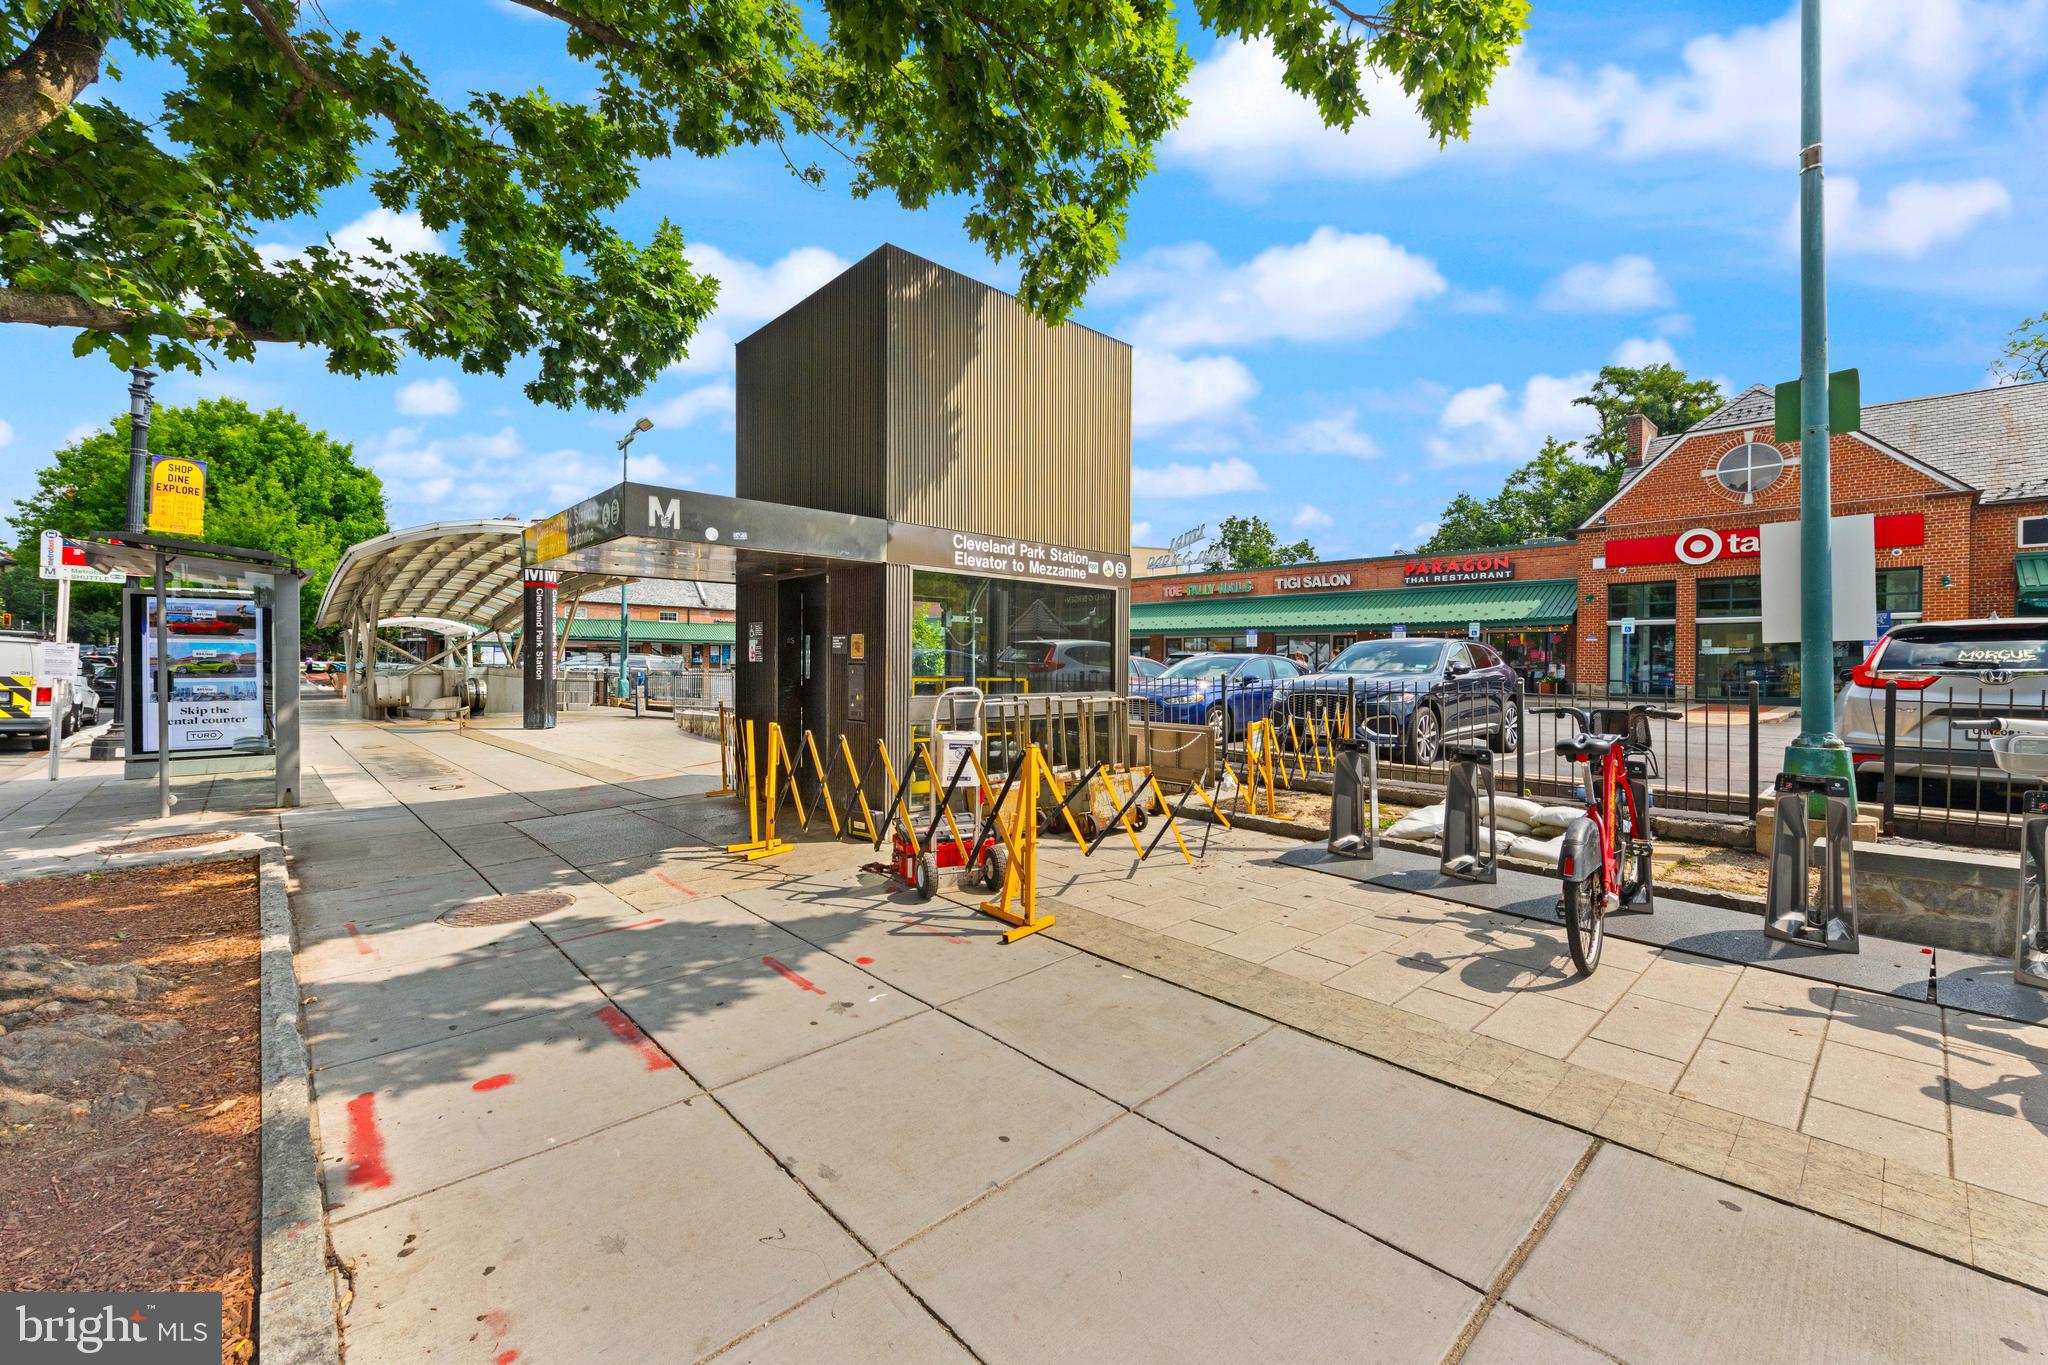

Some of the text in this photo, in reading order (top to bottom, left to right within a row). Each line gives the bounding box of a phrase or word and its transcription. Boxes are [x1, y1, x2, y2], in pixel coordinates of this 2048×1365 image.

[168, 463, 193, 474] SHOP
[168, 474, 190, 485] DINE
[156, 482, 200, 496] EXPLORE
[648, 495, 680, 530] M
[952, 533, 1088, 565] Cleveland Park Station
[44, 567, 56, 576] M
[954, 551, 1087, 579] Elevator to Mezzanine
[1405, 555, 1511, 577] PARAGON
[71, 574, 110, 582] SHUTTLE
[1275, 574, 1351, 589] TIGI SALON
[1404, 570, 1512, 584] THAI RESTAURANT
[535, 588, 544, 680] Cleveland Park Station
[180, 706, 230, 717] Skip the
[167, 716, 248, 726] ental counter
